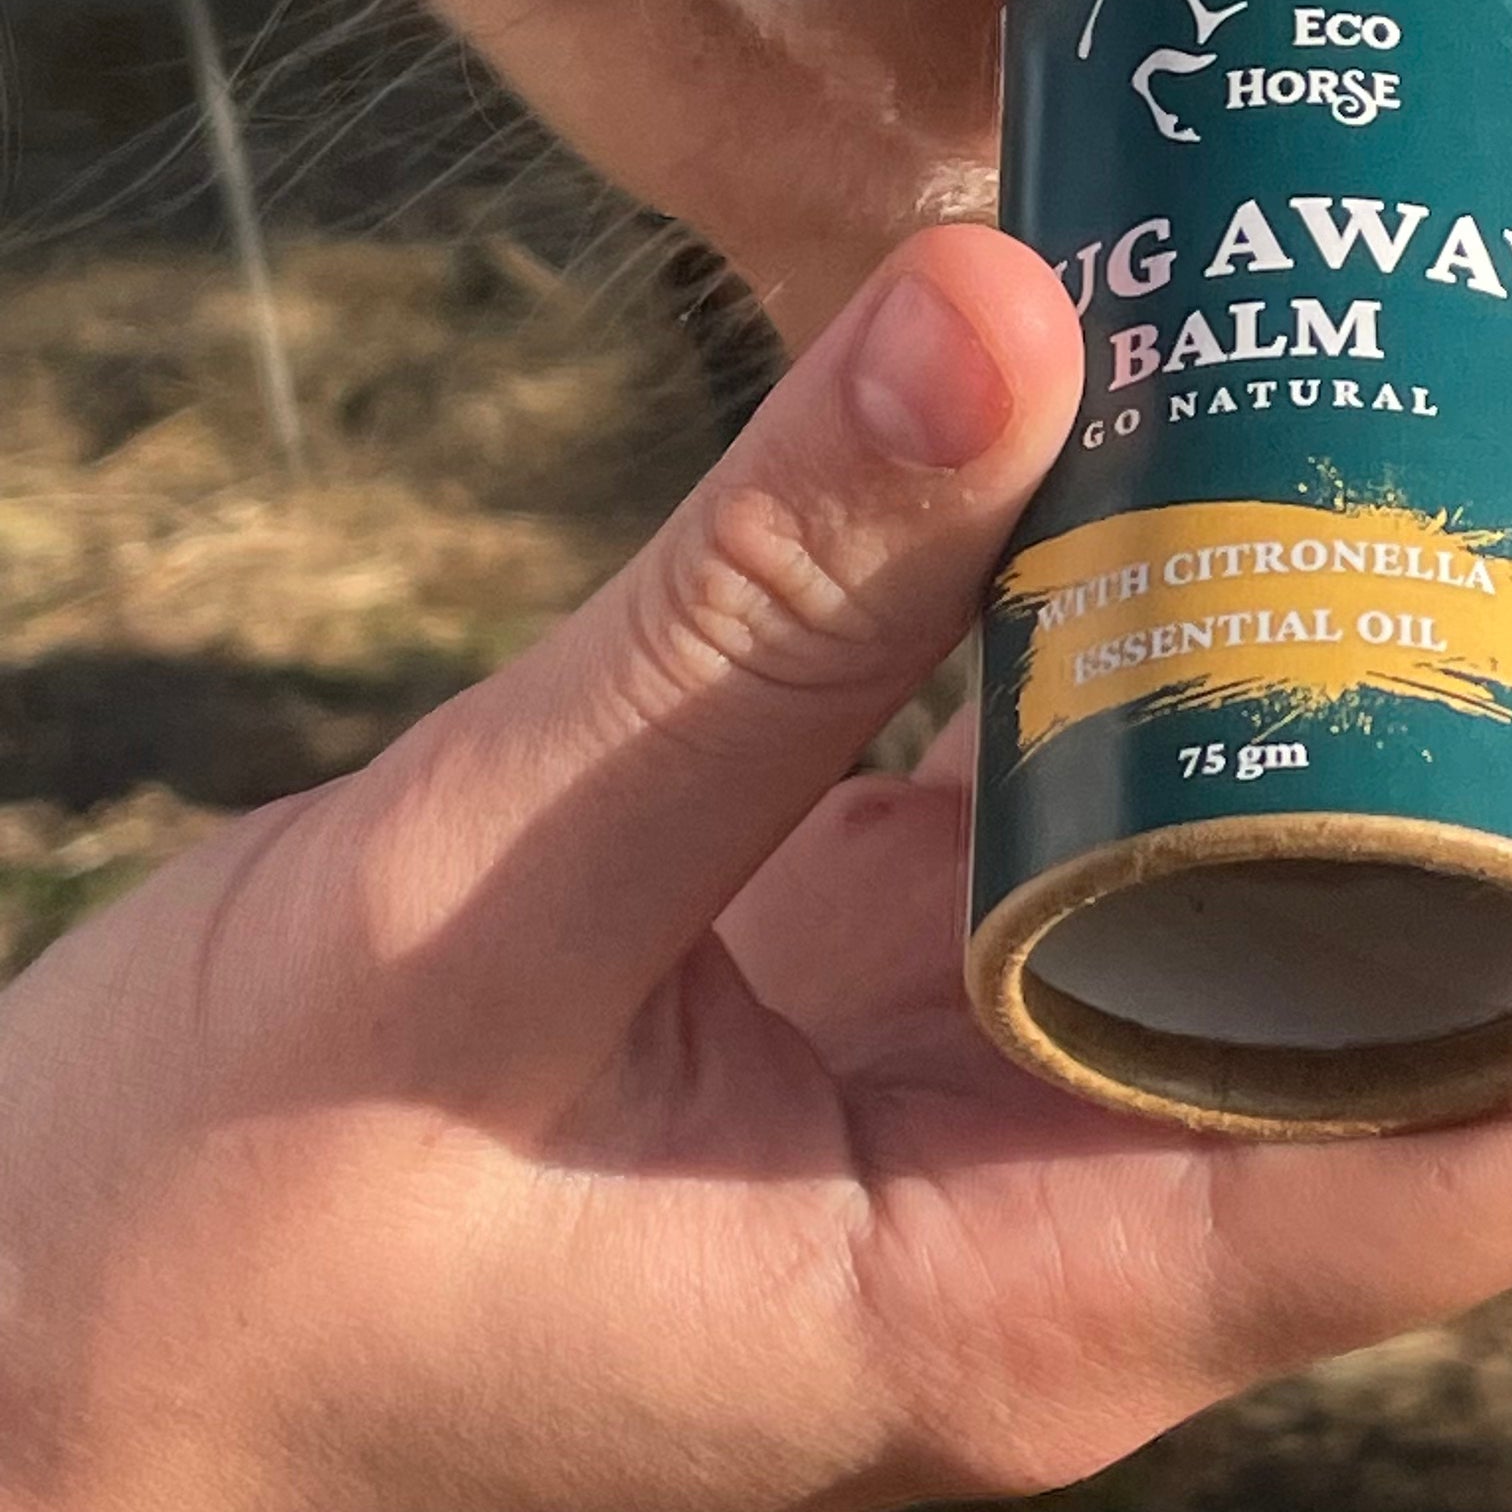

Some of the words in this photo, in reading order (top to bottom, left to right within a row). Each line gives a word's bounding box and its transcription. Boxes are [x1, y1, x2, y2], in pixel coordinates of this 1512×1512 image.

[1293, 8, 1401, 50] ECO
[1226, 69, 1402, 126] HORSE
[1054, 218, 1177, 317] UG
[1109, 299, 1385, 390] BALM
[1083, 410, 1140, 450] GO
[1169, 379, 1439, 423] NATURAL
[1037, 562, 1150, 633] WITH
[1163, 538, 1496, 595] CITRONELLA
[1073, 608, 1342, 686] ESSENTIAL
[1357, 610, 1448, 653] OIL
[1178, 745, 1225, 779] 75
[1237, 740, 1309, 781] gm
